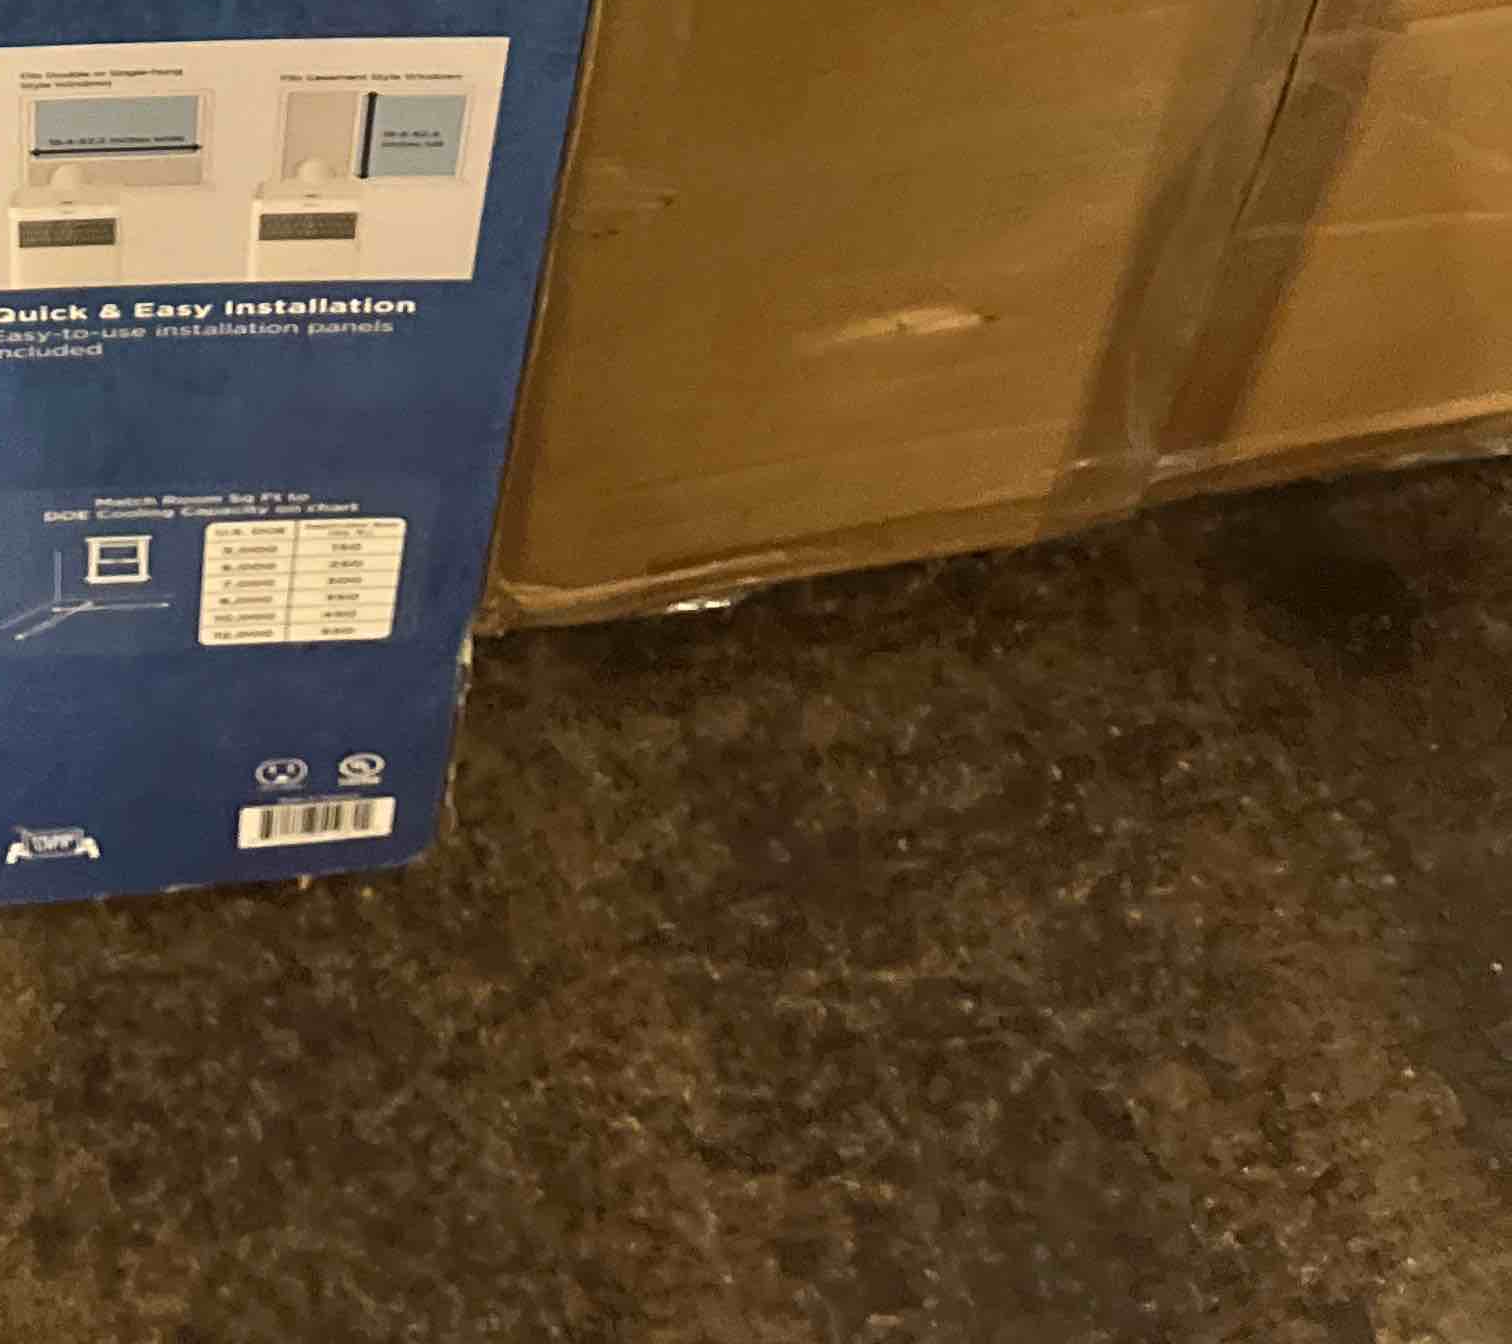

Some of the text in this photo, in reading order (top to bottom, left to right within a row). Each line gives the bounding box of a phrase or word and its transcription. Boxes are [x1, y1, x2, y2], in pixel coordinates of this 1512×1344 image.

[98, 300, 122, 321] &
[133, 300, 214, 322] Easy
[225, 296, 417, 317] Installation
[155, 319, 301, 338] installation
[306, 318, 395, 336] panels
